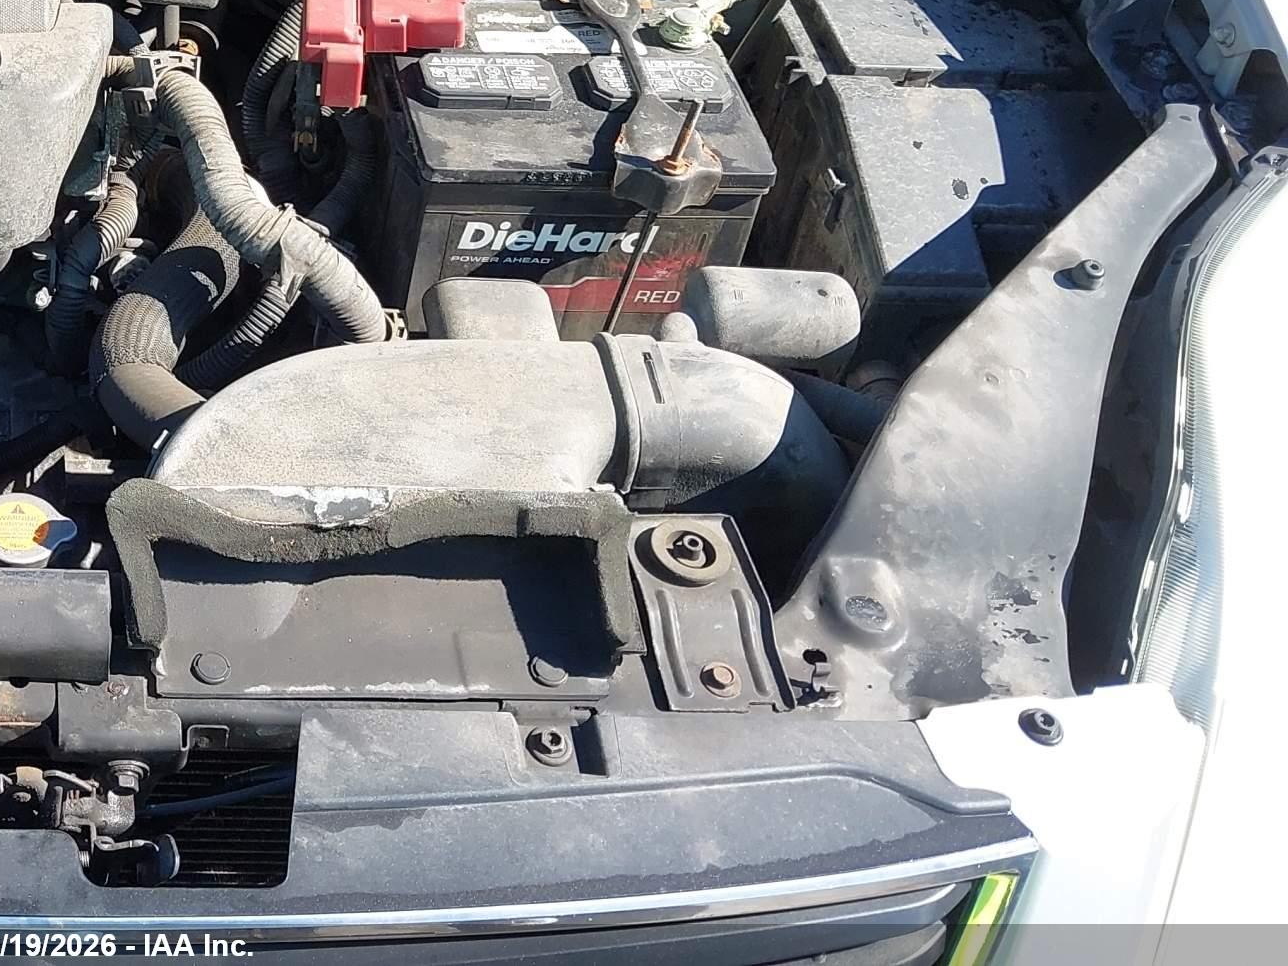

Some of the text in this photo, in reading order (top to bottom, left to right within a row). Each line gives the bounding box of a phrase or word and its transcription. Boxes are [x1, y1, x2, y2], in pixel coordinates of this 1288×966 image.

[577, 29, 601, 37] RED
[457, 220, 660, 254] DieHard
[450, 256, 552, 264] POWER AHEAD
[633, 290, 681, 304] RED
